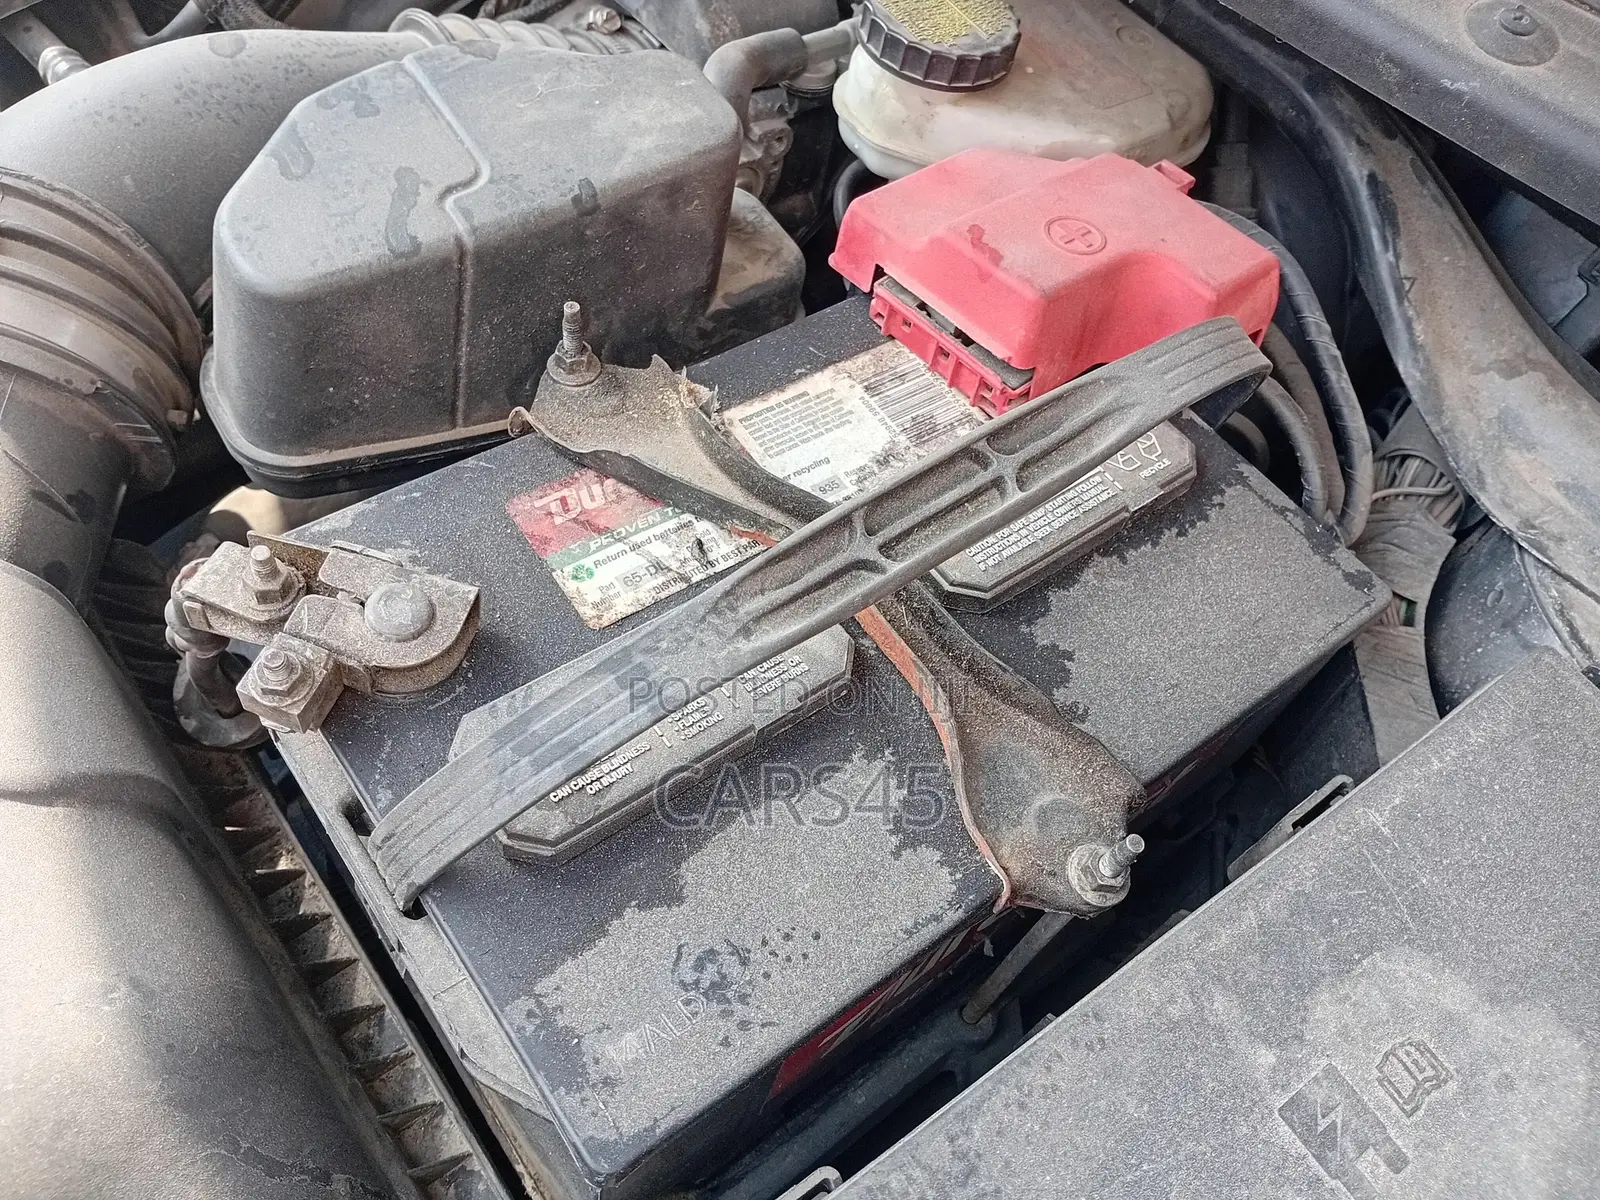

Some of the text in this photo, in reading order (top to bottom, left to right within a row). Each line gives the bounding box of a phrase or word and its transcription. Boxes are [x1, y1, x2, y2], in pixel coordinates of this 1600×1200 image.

[793, 456, 831, 479] recycling
[1139, 458, 1171, 479] RECYCLE
[819, 480, 840, 495] 935
[995, 527, 1012, 540] FOR
[1010, 518, 1029, 532] SAFE
[1028, 508, 1046, 523] JUMP
[1046, 490, 1078, 511] STARTING
[1075, 475, 1103, 495] FOLLOW
[589, 513, 660, 553] PROVEN
[973, 533, 1020, 563] INSTRUCTIONS
[1019, 528, 1029, 538] IN
[1027, 512, 1056, 532] VEHICLE
[979, 562, 986, 571] IF
[986, 554, 1002, 567] NOT
[1002, 535, 1035, 558] AVAILABLE
[1033, 526, 1054, 539] SEEK
[1054, 509, 1079, 529] SERVICE
[593, 548, 628, 569] Return
[629, 535, 652, 552] used
[653, 539, 762, 595] DISTRIBUTED BY BEST PAR
[599, 582, 616, 594] Part
[623, 560, 669, 587] 65-DL
[590, 591, 621, 609] Number
[739, 654, 785, 683] CAN CAUSE
[744, 655, 802, 692] BLINDNESS OR
[750, 663, 809, 700] SEVERE BURNS
[549, 785, 573, 802] CAN
[570, 768, 603, 790] CAUSE
[601, 741, 651, 773] BLINDNESS
[586, 762, 634, 795] OR INJURY
